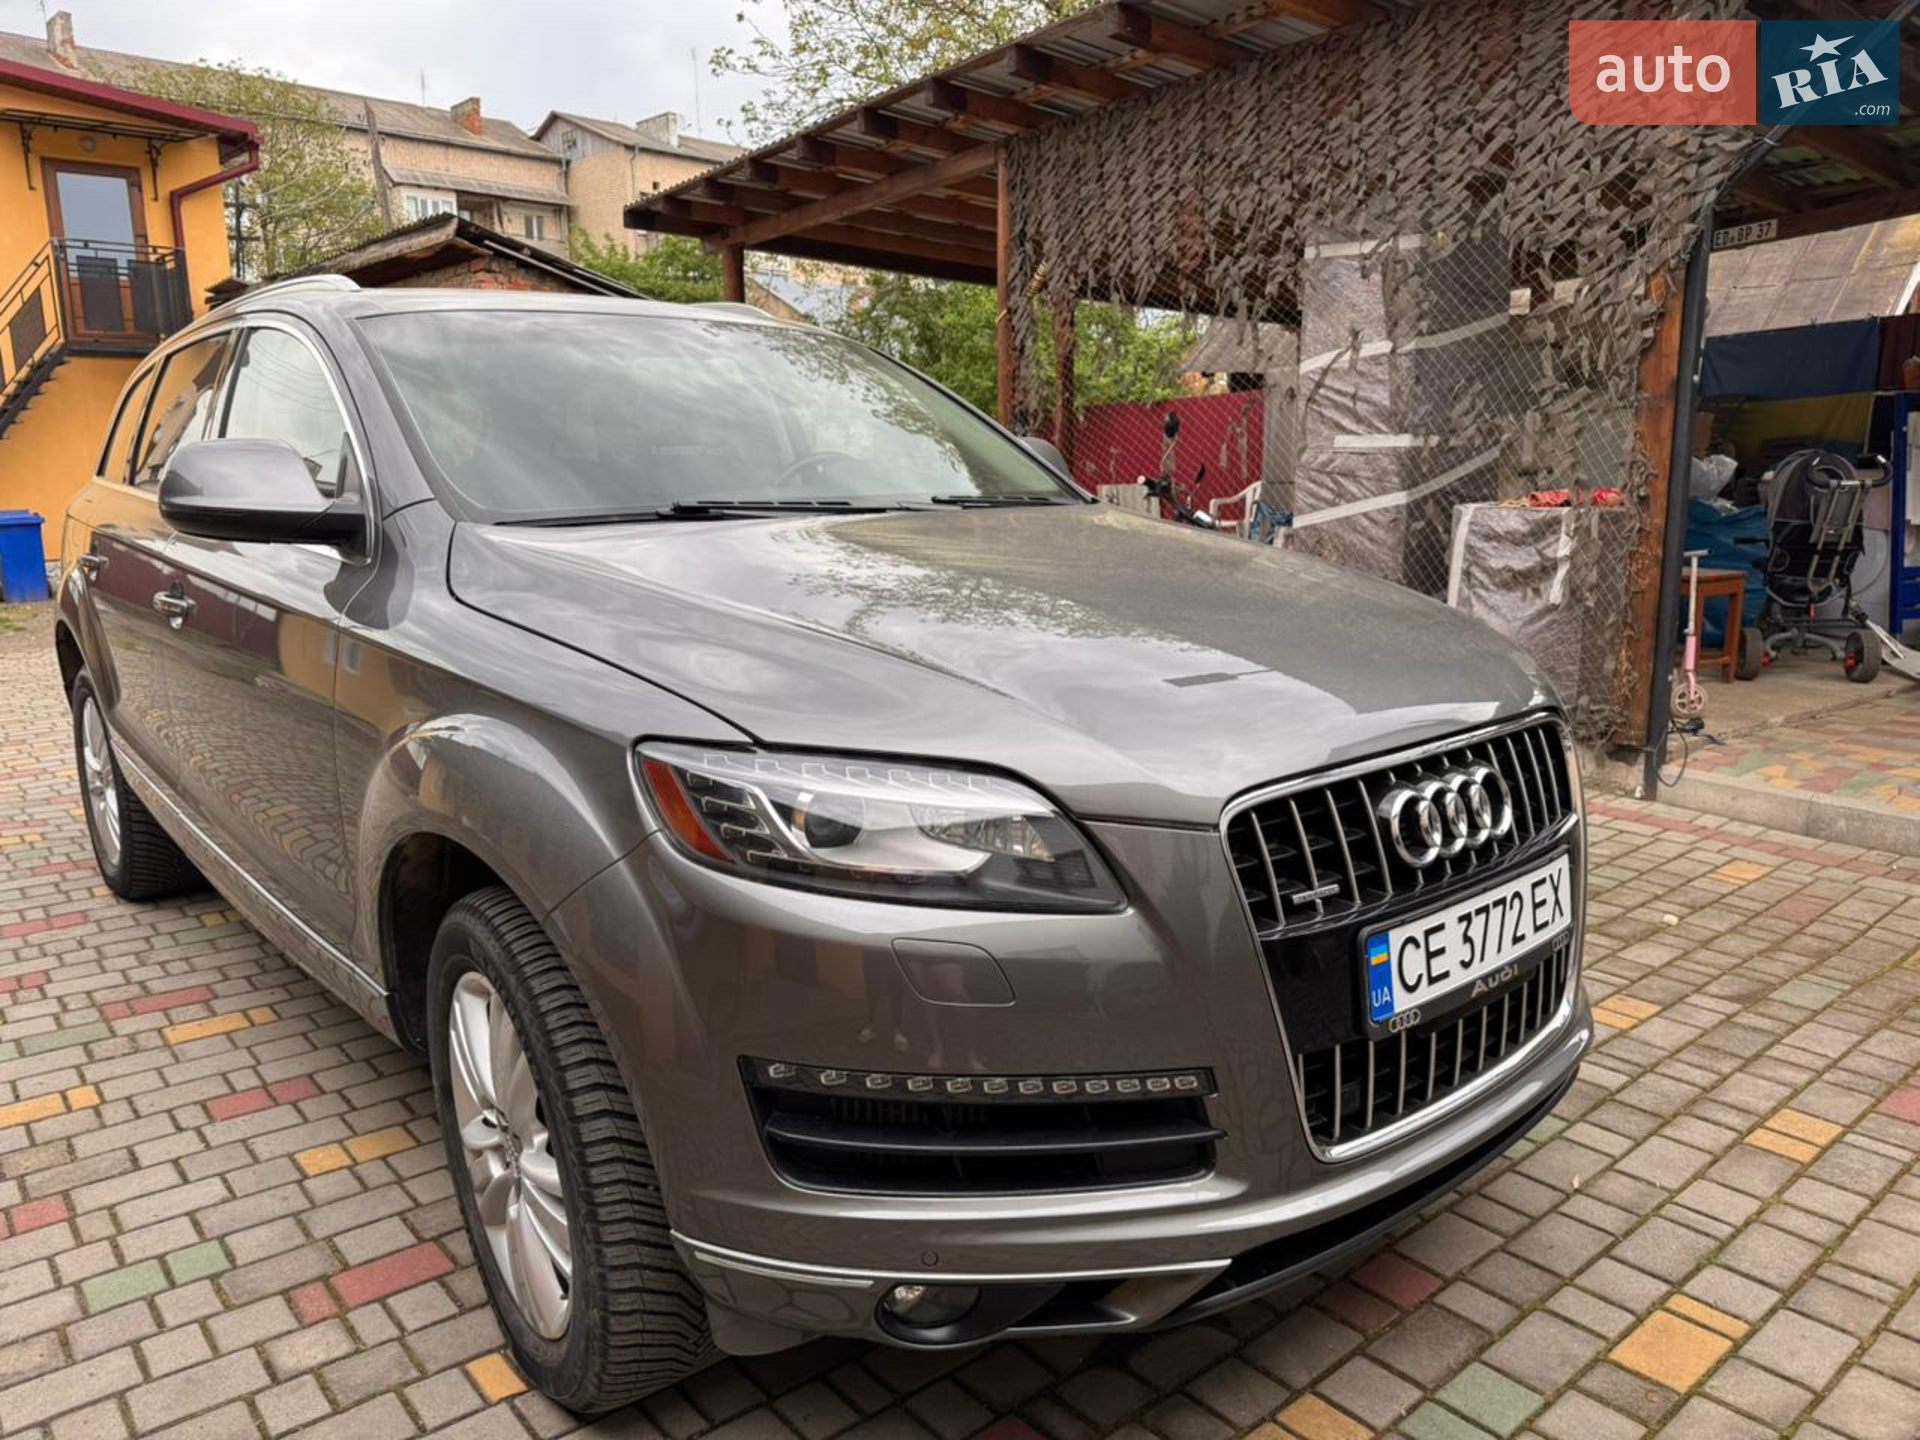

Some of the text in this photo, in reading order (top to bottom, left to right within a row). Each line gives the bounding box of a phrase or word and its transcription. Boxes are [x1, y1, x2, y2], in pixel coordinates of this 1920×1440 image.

[1757, 222, 1771, 238] 37
[1398, 867, 1564, 994] CE 3772 EX
[1372, 986, 1390, 1007] UA
